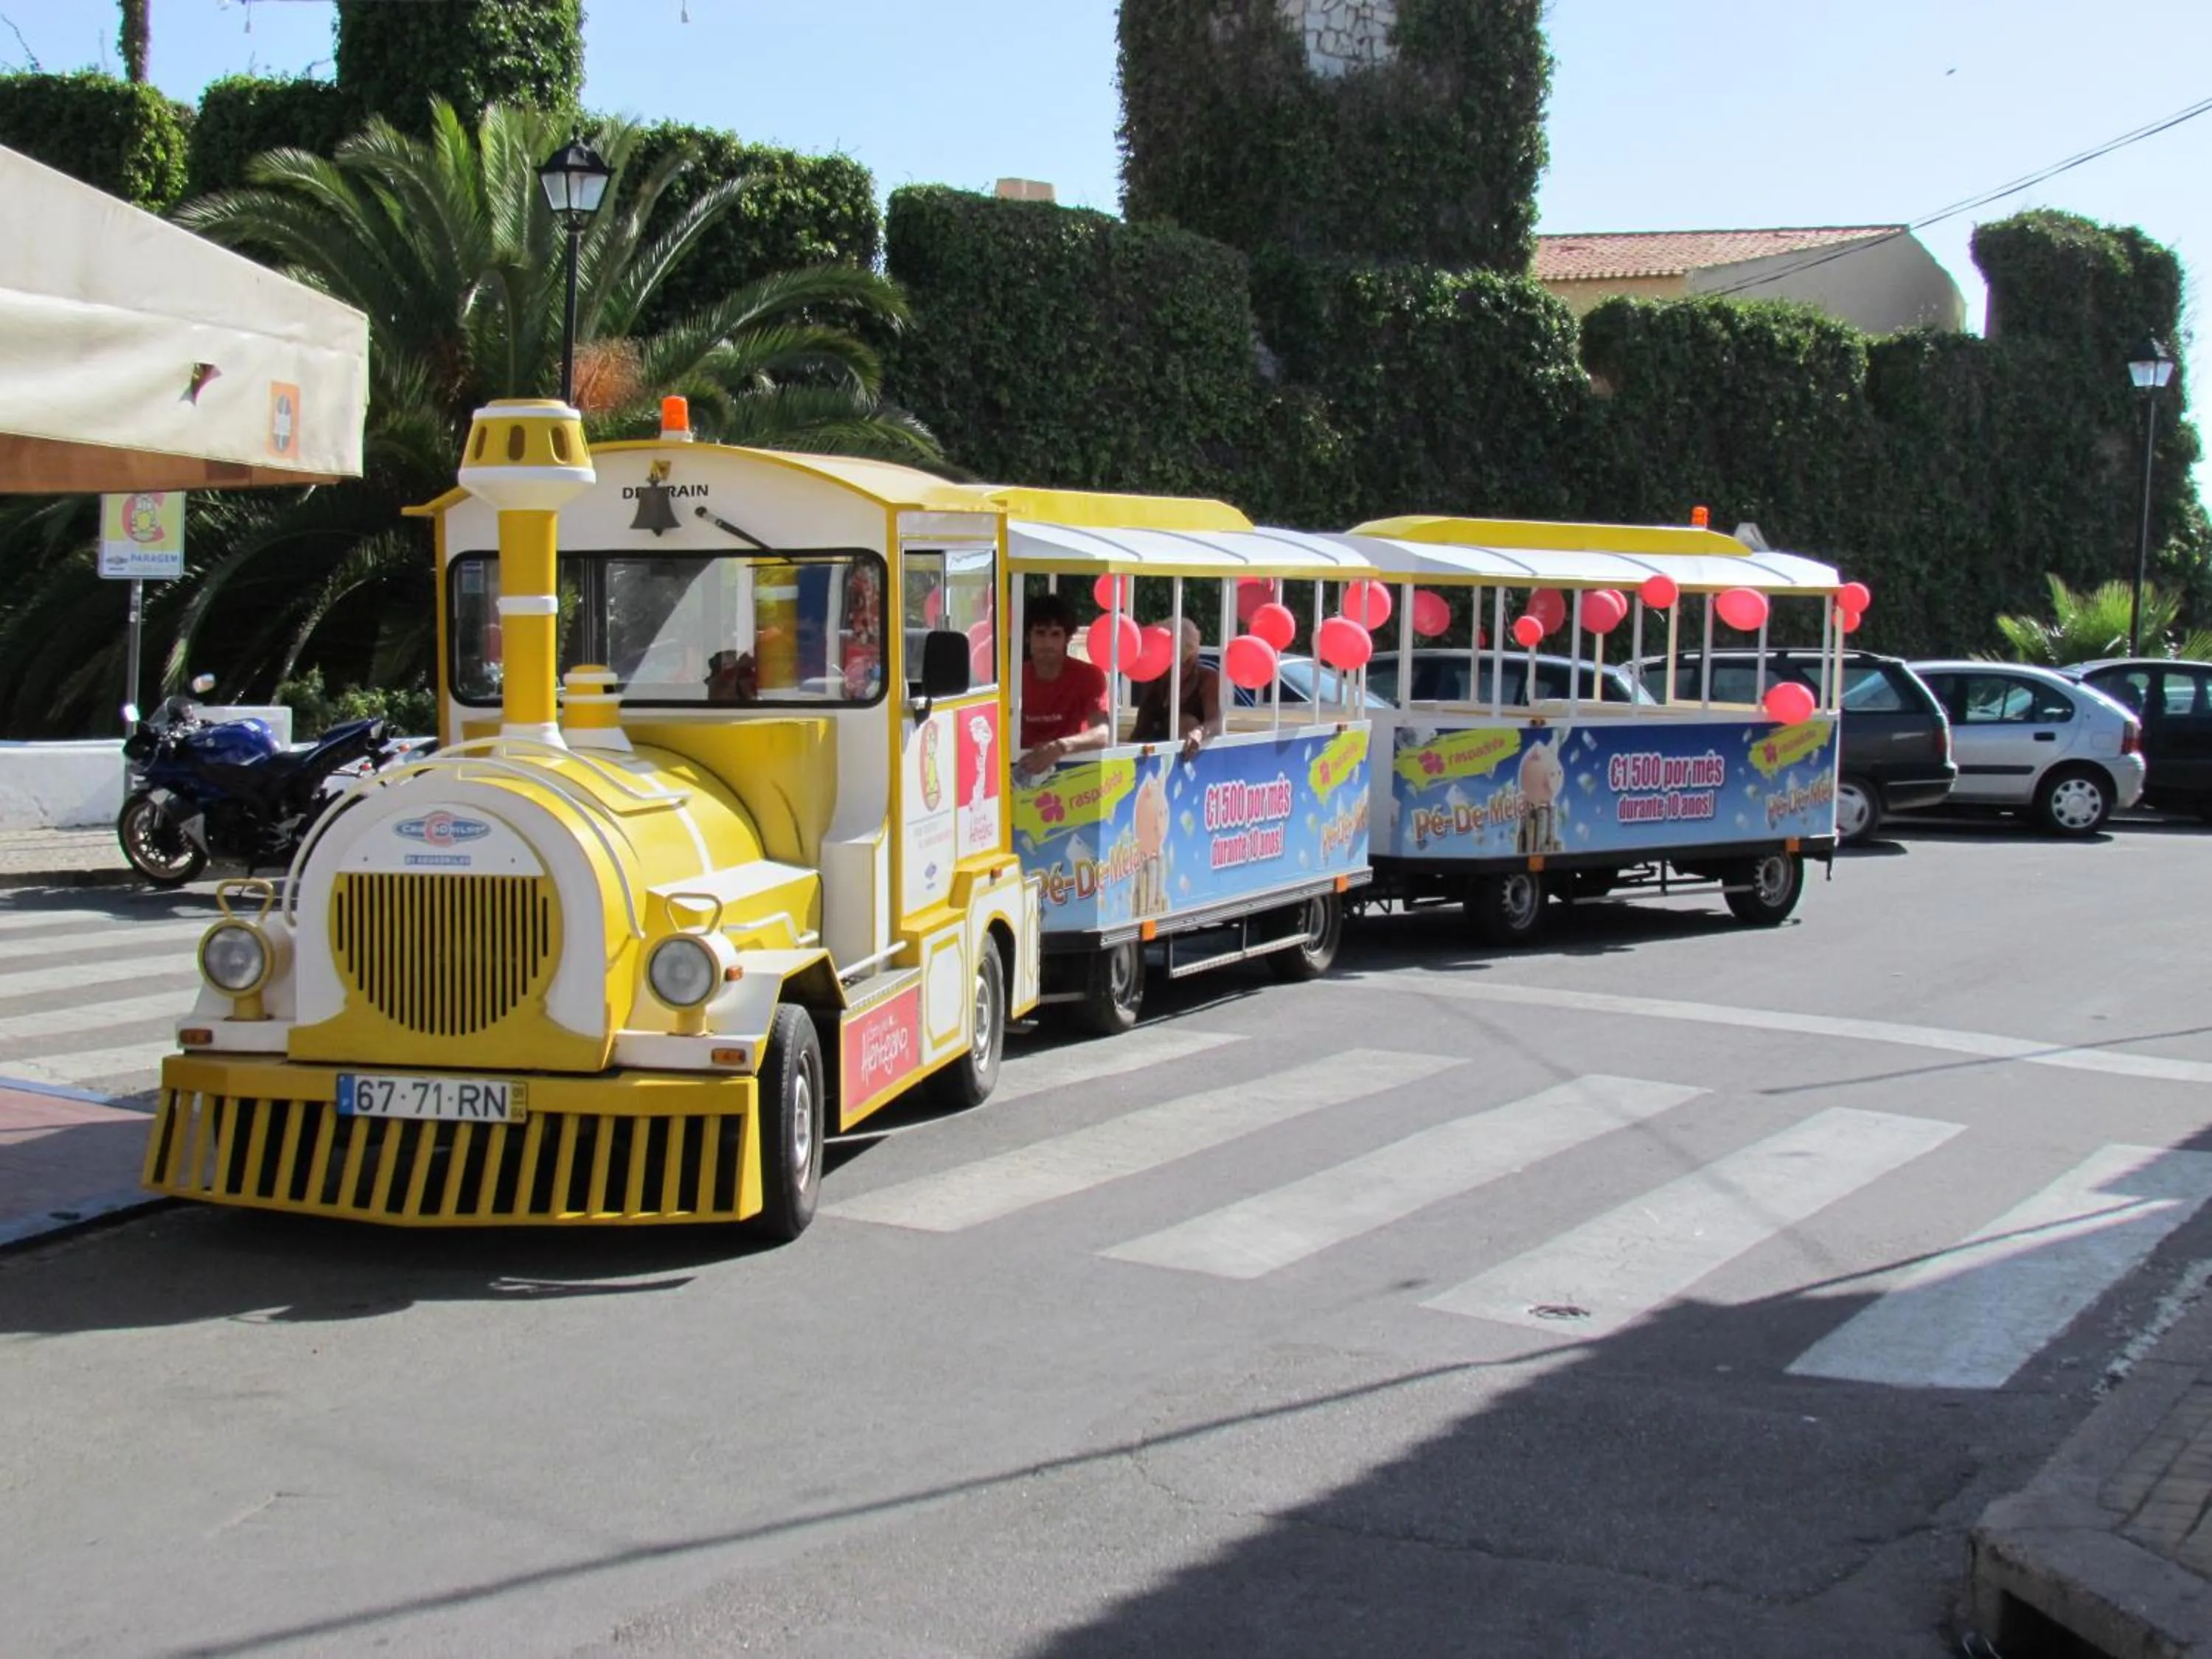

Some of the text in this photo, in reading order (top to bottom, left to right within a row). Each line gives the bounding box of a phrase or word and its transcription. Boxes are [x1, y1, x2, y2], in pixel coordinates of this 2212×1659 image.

[622, 484, 709, 499] DRAIN
[1663, 758, 1688, 790] por
[1691, 750, 1724, 786] mês
[1247, 785, 1266, 827] por
[1267, 773, 1290, 817] mês
[1618, 791, 1713, 821] durante 10 anos!
[1211, 824, 1284, 868] durante 10 anos!
